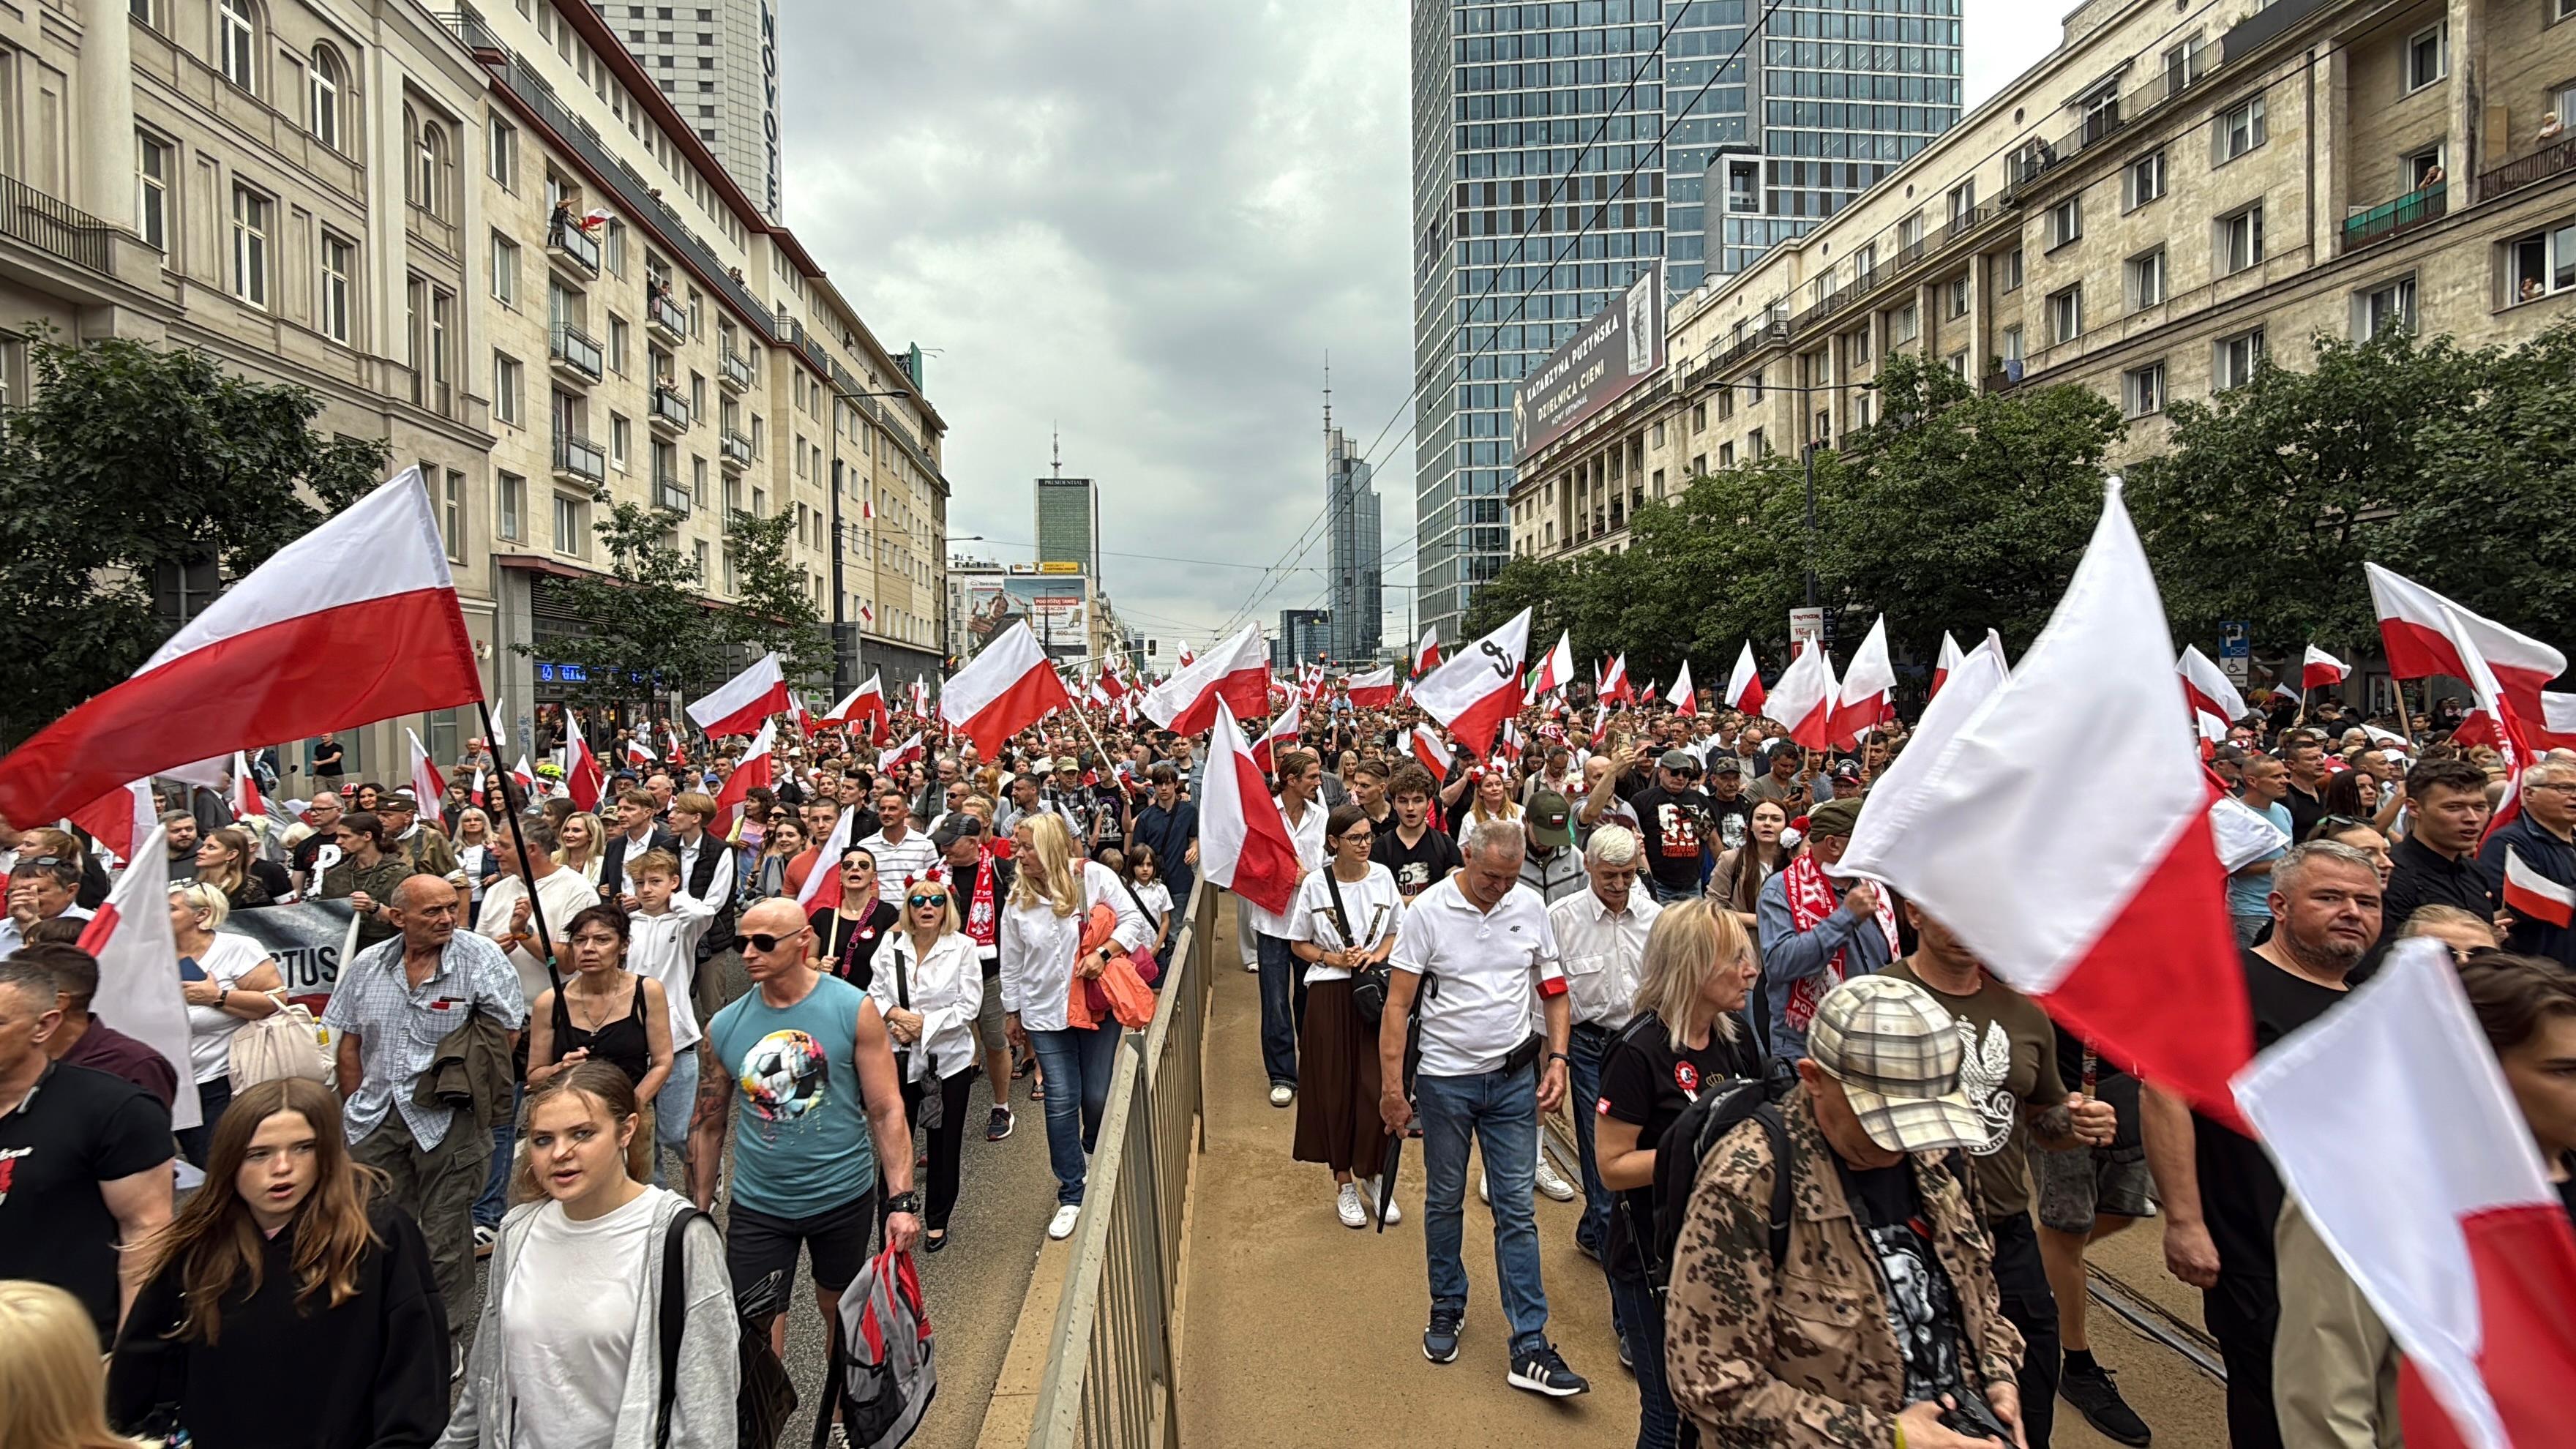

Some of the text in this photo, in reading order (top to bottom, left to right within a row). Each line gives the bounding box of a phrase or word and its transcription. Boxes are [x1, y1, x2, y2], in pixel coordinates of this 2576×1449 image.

[761, 0, 777, 214] NOVOTE
[1527, 314, 1619, 402] KATARZYNA PUZYŃSKA
[1538, 383, 1578, 422] DZIELNICA
[1580, 359, 1605, 389] CIENI
[1551, 411, 1565, 427] NOWY
[2225, 624, 2243, 647] P
[1793, 998, 1811, 1017] POL
